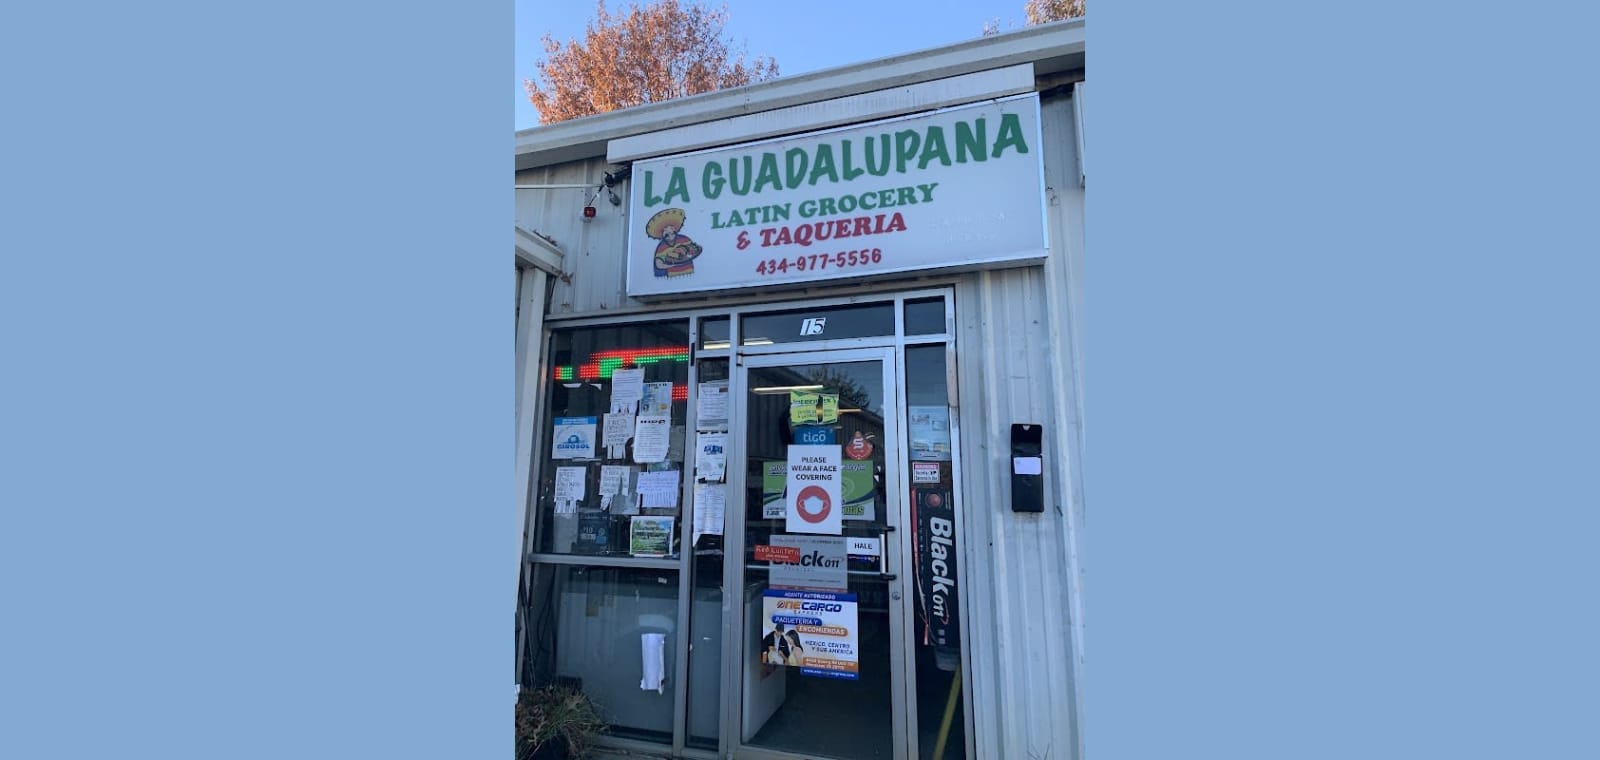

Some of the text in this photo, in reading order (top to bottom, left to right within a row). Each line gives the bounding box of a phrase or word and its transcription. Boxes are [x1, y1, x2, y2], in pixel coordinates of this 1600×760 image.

[643, 113, 1029, 208] LA GUADALUPANA
[711, 182, 939, 229] LATIN GROCERY
[736, 231, 751, 251] &
[760, 212, 907, 247] TAQUERIA
[755, 248, 882, 275] 434-977-5556
[801, 318, 825, 336] 15
[801, 456, 827, 464] PLEASE
[854, 542, 873, 550] HALE
[929, 516, 954, 594] Black
